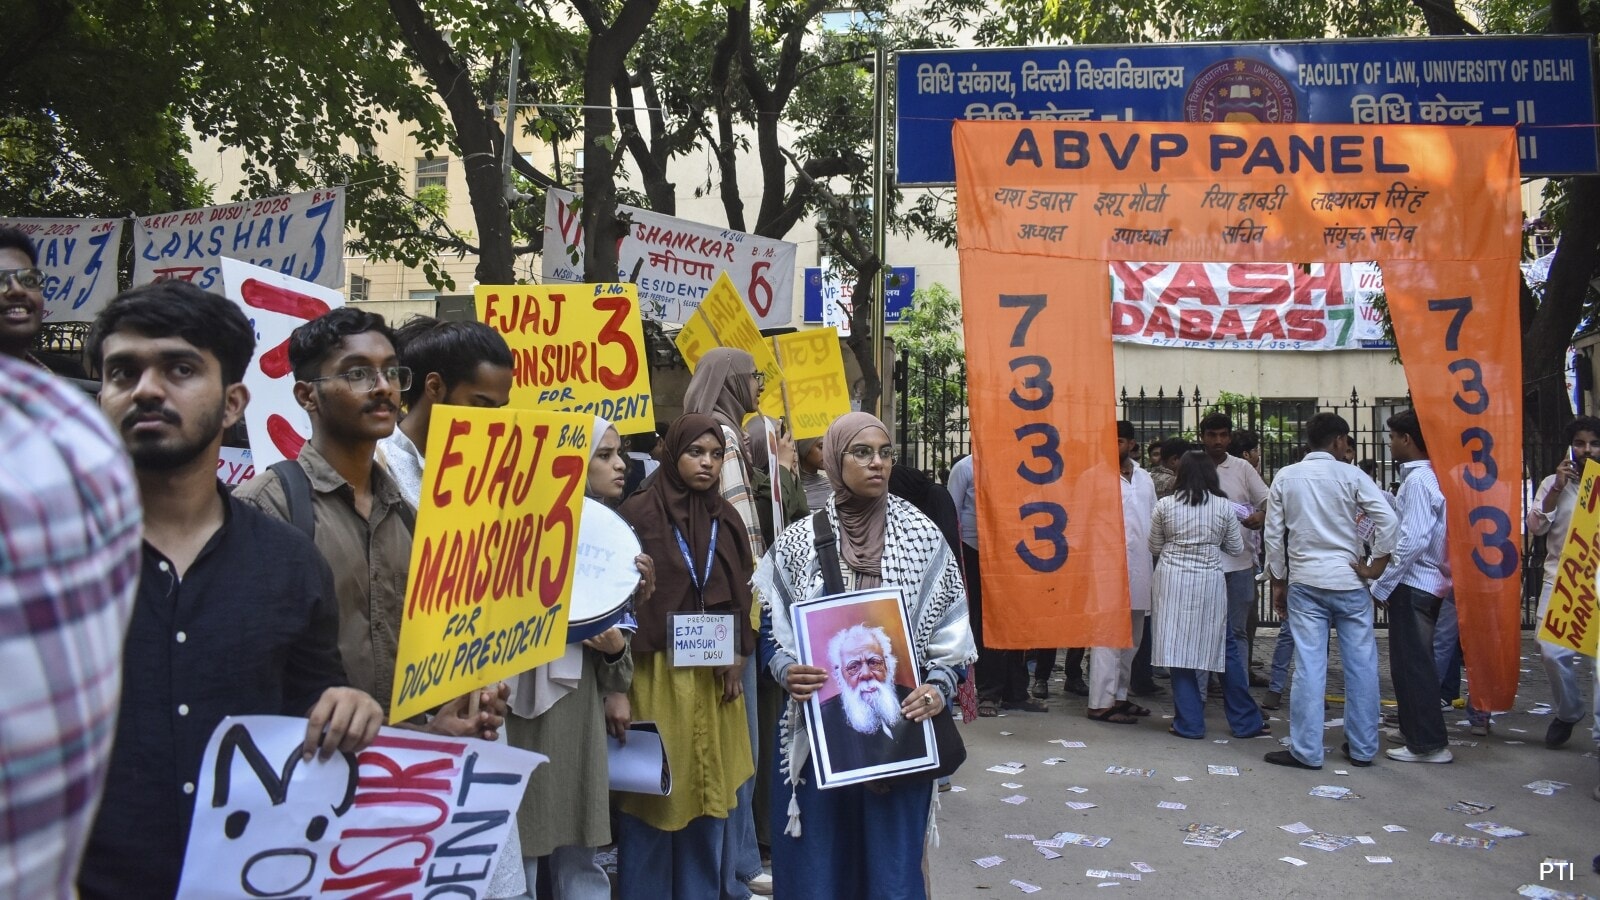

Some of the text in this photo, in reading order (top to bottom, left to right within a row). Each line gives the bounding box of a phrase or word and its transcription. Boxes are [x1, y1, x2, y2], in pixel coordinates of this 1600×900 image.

[916, 58, 1185, 99] विधि संकाय, दिल्ली विश्वविद्यालय
[1299, 59, 1575, 88] FACULTY OF LAW, UNIVERSITY OF DELHI
[1351, 93, 1412, 124] विधि
[1418, 93, 1484, 126] केन्द्र
[1005, 128, 1410, 174] ABVP PANEL
[180, 211, 204, 227] FOR
[1026, 190, 1078, 213] डबास
[142, 213, 294, 262] LAKSHAY
[636, 222, 735, 263] SHANKKAR
[720, 229, 745, 242] NSUI
[1017, 223, 1069, 243] अध्यक्ष
[1111, 227, 1173, 247] उपाध्यक्ष
[1221, 218, 1268, 245] सचिव
[1370, 218, 1418, 243] सचिव
[648, 249, 715, 282] मीणा
[747, 260, 774, 318] 6
[484, 293, 566, 337] EJAJ
[999, 294, 1048, 348] 7
[1111, 301, 1328, 341] DABAAS
[1328, 308, 1355, 346] 7
[1428, 296, 1473, 351] 7
[512, 340, 599, 389] ANSURI
[593, 296, 639, 391] 3
[538, 387, 576, 404] FOR
[1009, 355, 1055, 411] 3
[1448, 358, 1490, 415] 3
[432, 418, 549, 509] EJAJ
[1015, 423, 1064, 485] 3
[1461, 427, 1498, 492] 3
[538, 455, 584, 608] 3
[1015, 501, 1069, 573] 3
[1469, 505, 1518, 579] 3
[408, 513, 544, 620] MANSURI
[1544, 527, 1590, 640] EJAJ
[442, 605, 482, 641] FOR
[675, 625, 704, 637] EJAJ
[397, 604, 562, 707] DUSU PRESIDENT
[675, 639, 716, 650] MANSURI
[703, 650, 723, 660] DUSU
